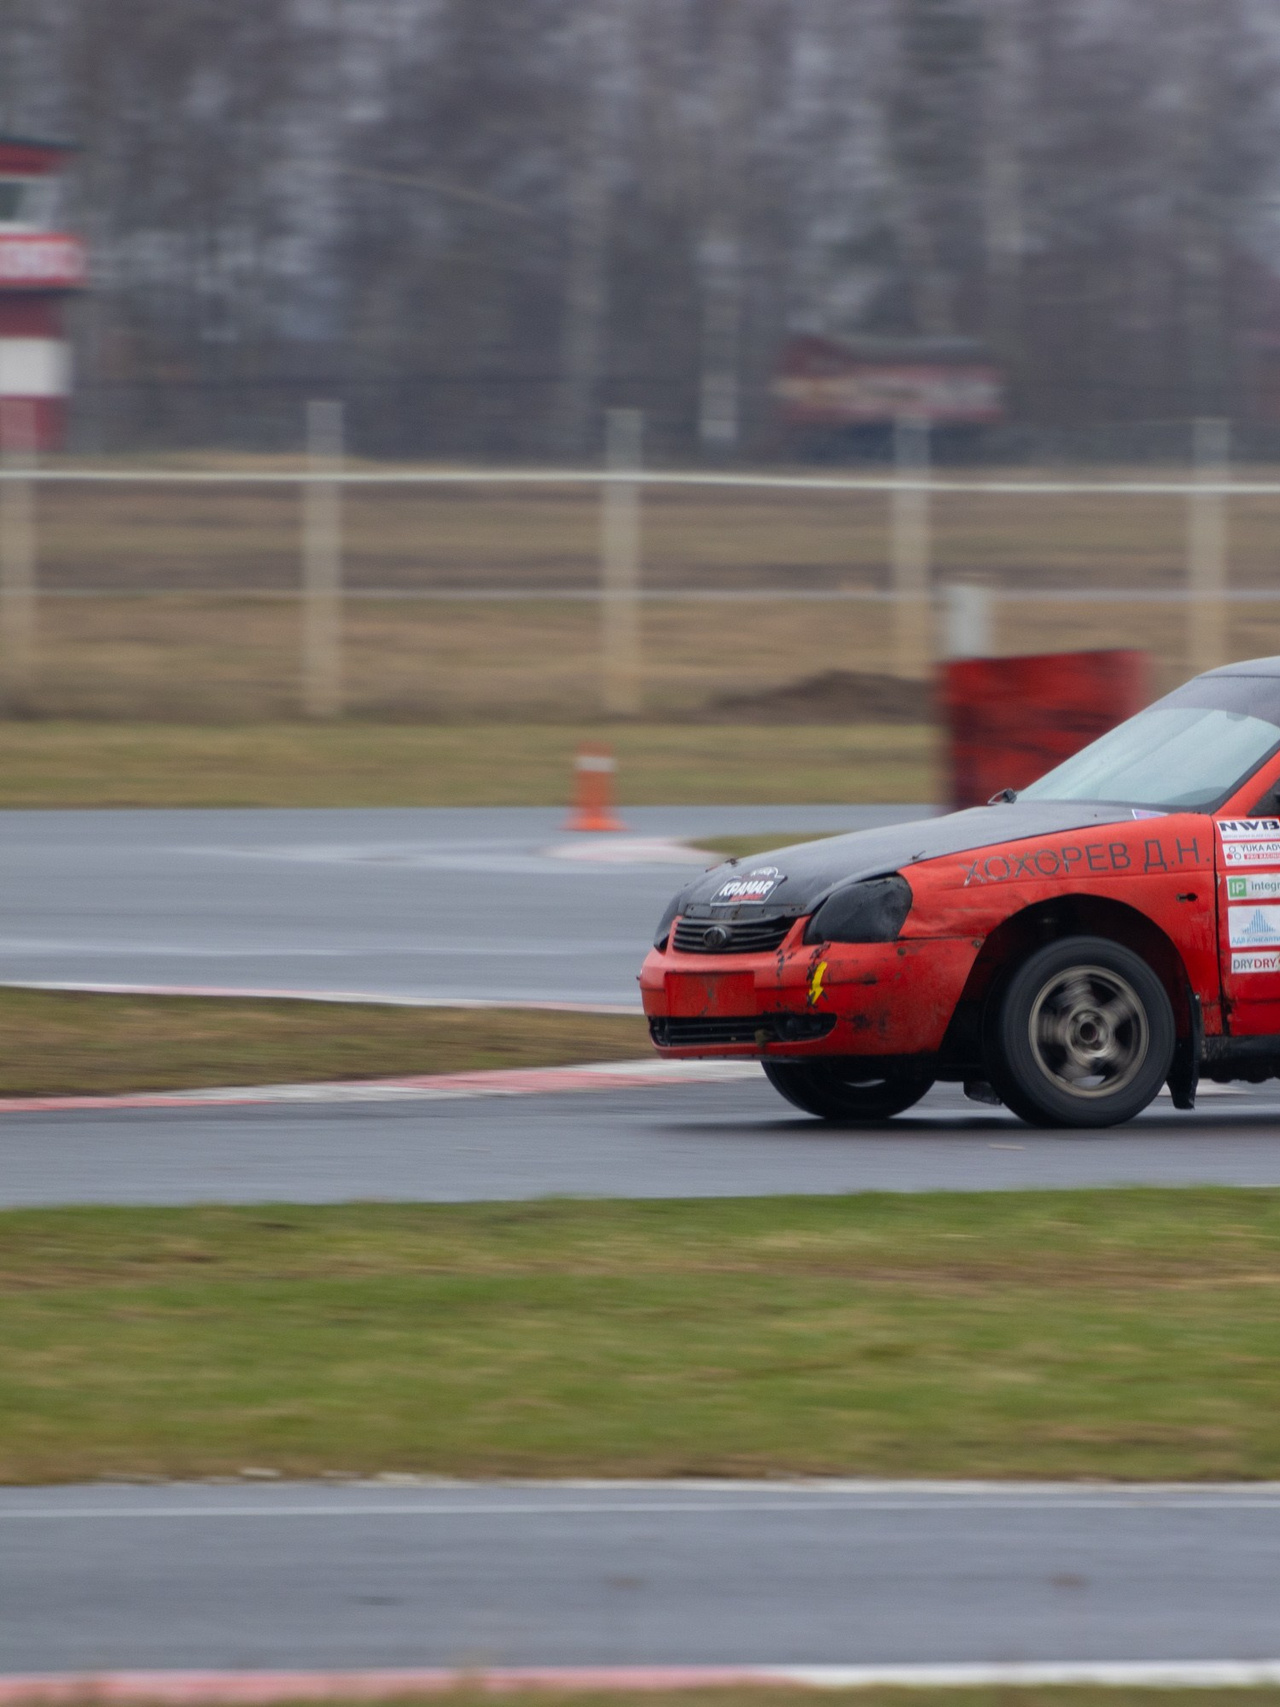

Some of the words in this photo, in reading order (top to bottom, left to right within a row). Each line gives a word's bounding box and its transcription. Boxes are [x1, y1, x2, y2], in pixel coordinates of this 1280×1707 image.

[1219, 820, 1280, 832] NWB
[1241, 844, 1264, 852] YUKA
[719, 880, 775, 897] KRAMAR
[1231, 881, 1245, 894] IP
